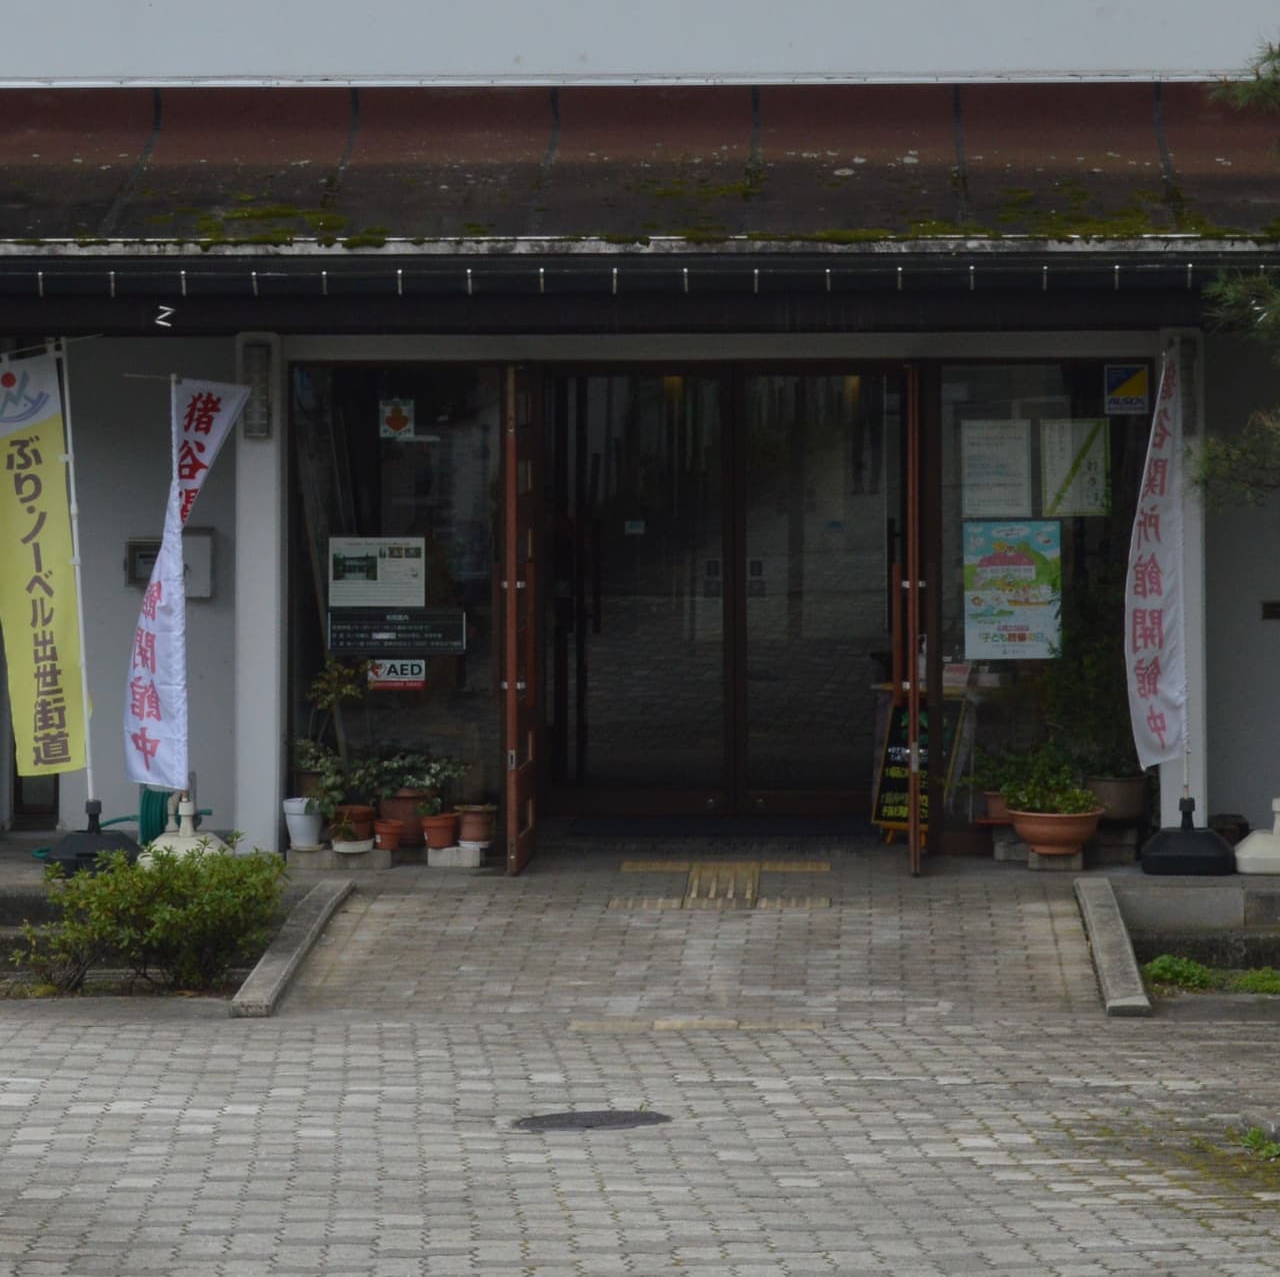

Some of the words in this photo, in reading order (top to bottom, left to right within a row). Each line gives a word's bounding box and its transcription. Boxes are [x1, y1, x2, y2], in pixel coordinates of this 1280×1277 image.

[6, 435, 72, 766] ぶり・ノーベル出世街道
[387, 664, 422, 676] AED
